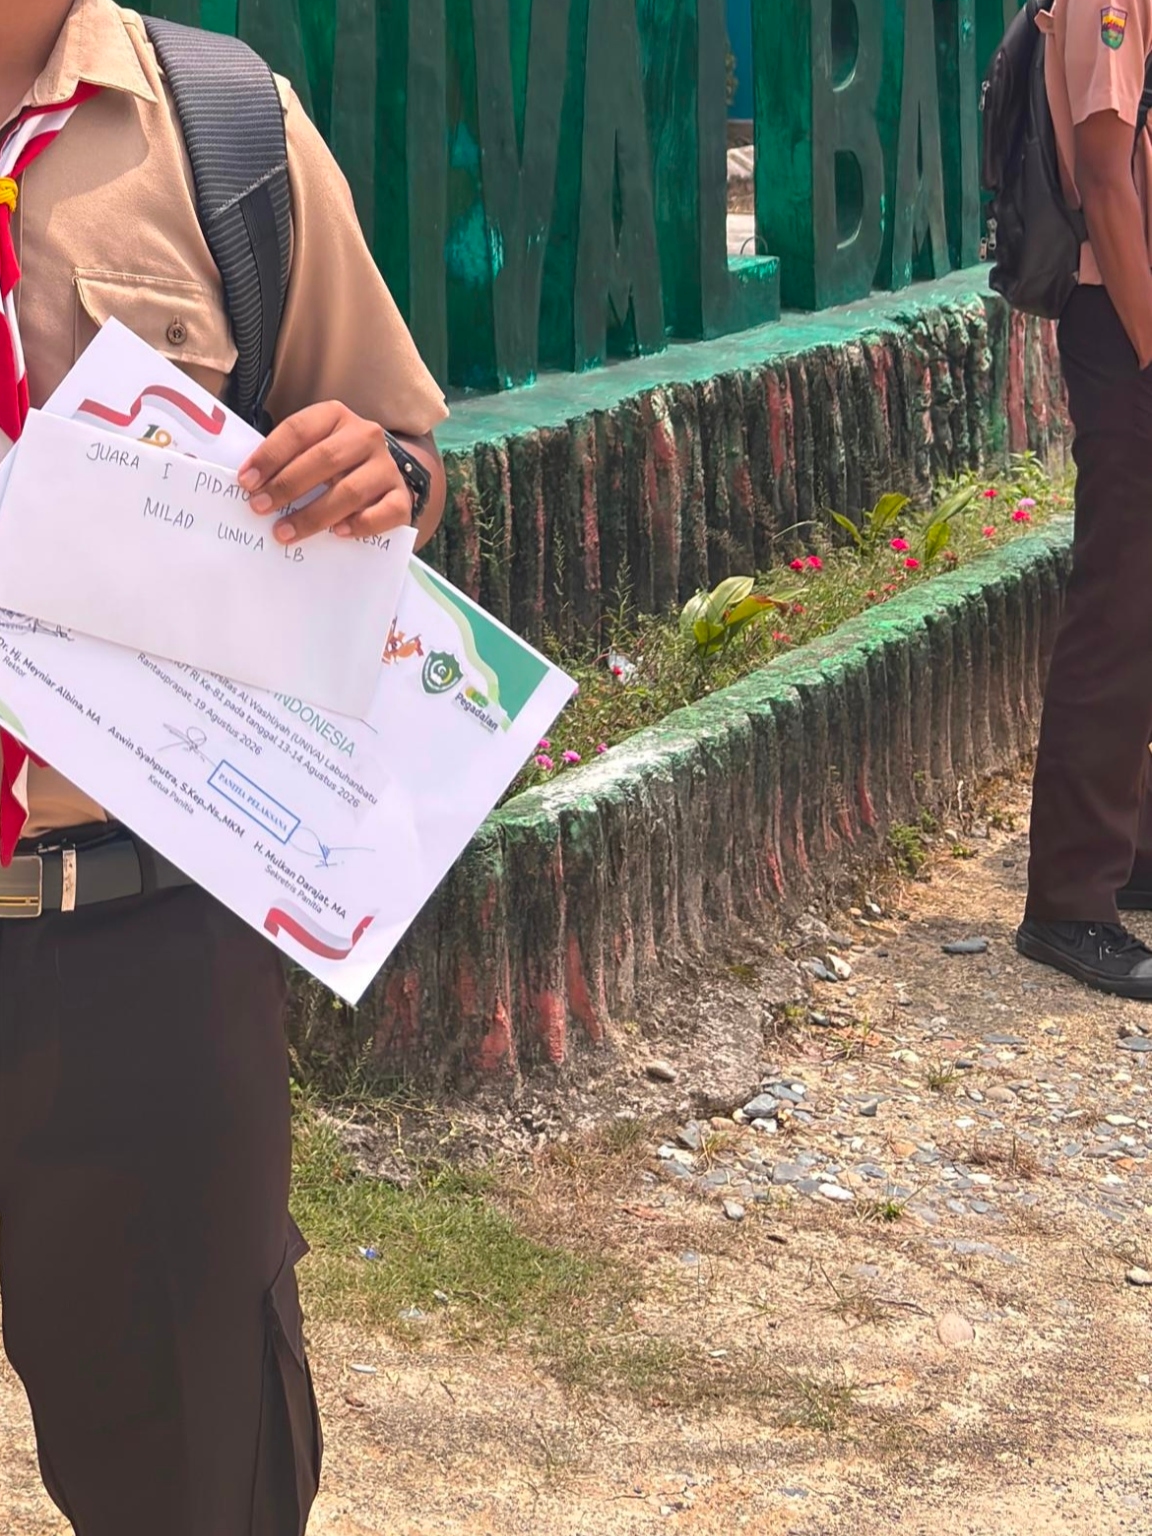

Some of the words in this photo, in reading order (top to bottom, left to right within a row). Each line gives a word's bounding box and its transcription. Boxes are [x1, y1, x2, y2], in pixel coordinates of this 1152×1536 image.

[86, 442, 140, 470] JUARA
[162, 462, 172, 479] I
[194, 472, 252, 502] PIDATO
[143, 497, 194, 529] MILAD
[217, 521, 264, 551] UNIVA
[283, 544, 304, 562] LB
[3, 655, 26, 677] Rektor
[7, 647, 21, 661] Hj.
[23, 658, 56, 687] Meyniar
[56, 686, 83, 713] Albina,
[86, 709, 100, 725] MA
[190, 669, 200, 681] RI
[199, 677, 224, 701] Ke-81
[223, 699, 245, 718] pada
[246, 715, 278, 744] tanggal
[278, 740, 303, 763] 13-14
[302, 761, 336, 790] Agustus
[337, 787, 360, 808] 2026
[194, 698, 206, 710] 19
[205, 708, 239, 738] Agustus
[239, 734, 262, 755] 2026
[250, 698, 290, 736] Washliyah
[290, 733, 324, 763] (UNIVA)
[324, 759, 377, 804] Labuhanbatu
[108, 727, 134, 750] Aswin
[135, 747, 177, 787] Syahputra,
[148, 774, 169, 795] Ketua
[169, 791, 194, 814] Panitia
[254, 841, 263, 854] H.
[265, 850, 296, 879] Mulkan
[297, 875, 329, 907] Darajat,
[331, 903, 346, 919] MA
[265, 864, 296, 893] Sekretris
[297, 890, 322, 914] Panitia
